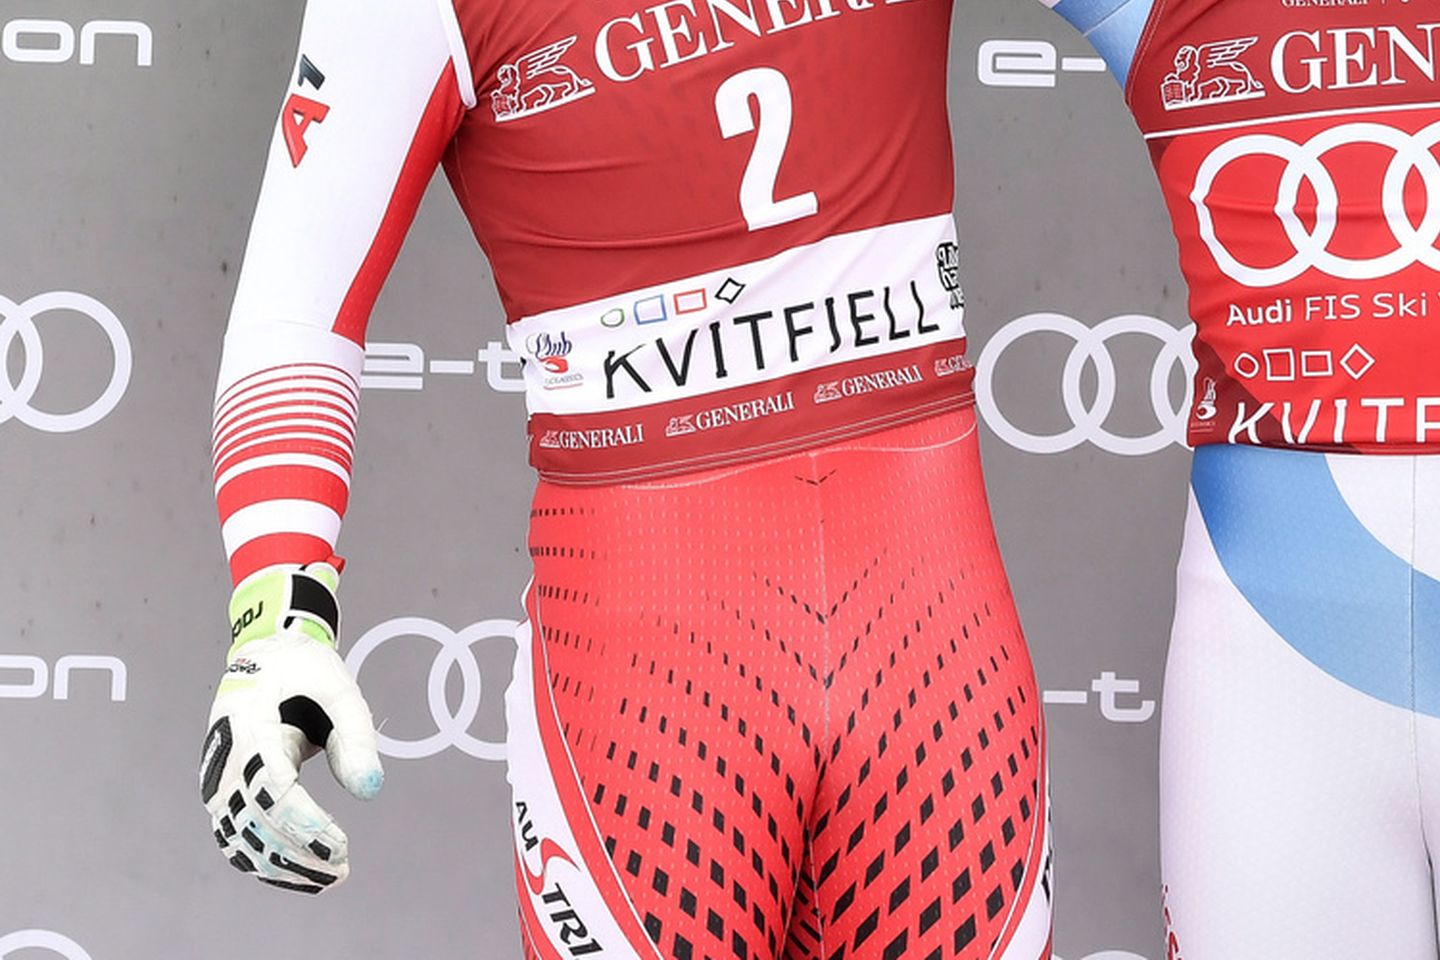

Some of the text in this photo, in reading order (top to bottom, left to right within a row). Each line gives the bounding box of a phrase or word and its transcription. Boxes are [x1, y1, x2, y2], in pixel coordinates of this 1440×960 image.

[715, 66, 818, 232] 2
[603, 280, 941, 399] KVITFJELL
[1226, 298, 1292, 327] Audi
[1305, 293, 1361, 321] FIS
[1372, 292, 1427, 318] Ski
[559, 365, 923, 450] GENERALI GENERALI GENERALI
